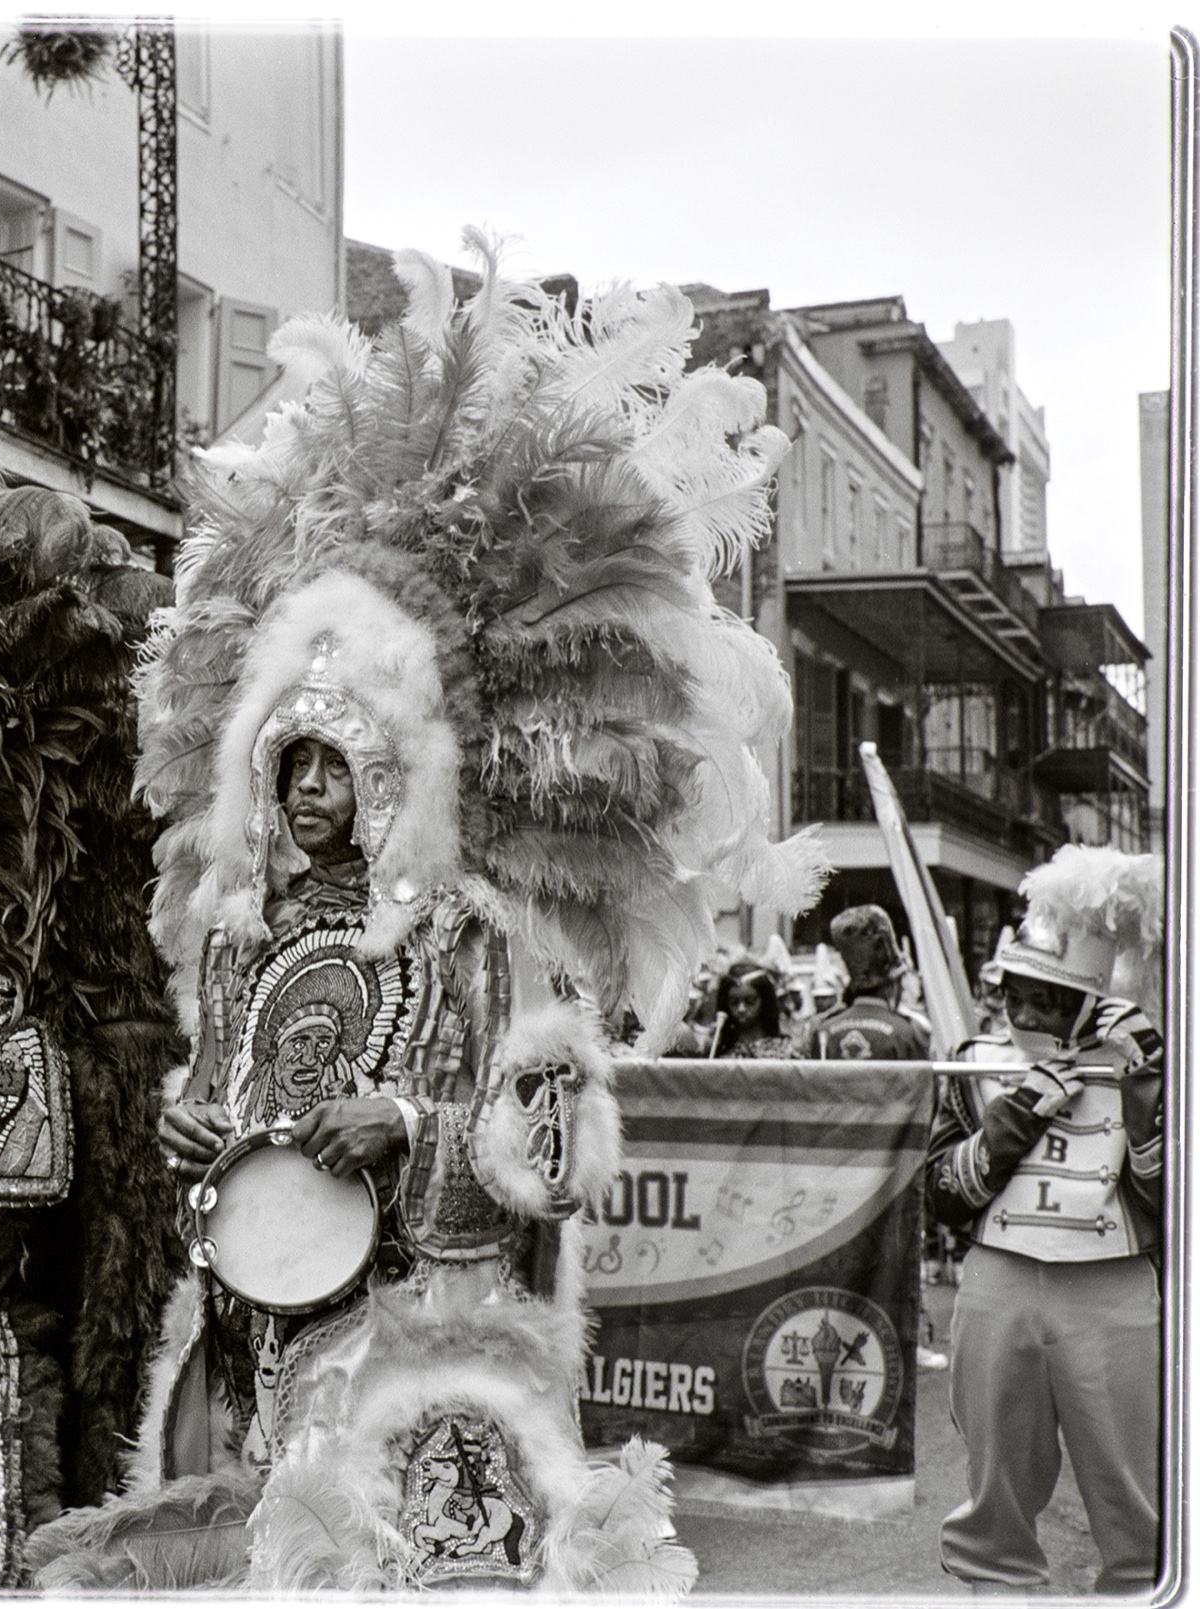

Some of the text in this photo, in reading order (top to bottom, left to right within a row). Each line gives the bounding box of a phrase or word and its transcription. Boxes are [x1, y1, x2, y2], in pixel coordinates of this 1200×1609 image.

[1041, 1133, 1068, 1163] B
[584, 1170, 702, 1231] OOL
[1036, 1180, 1060, 1212] L
